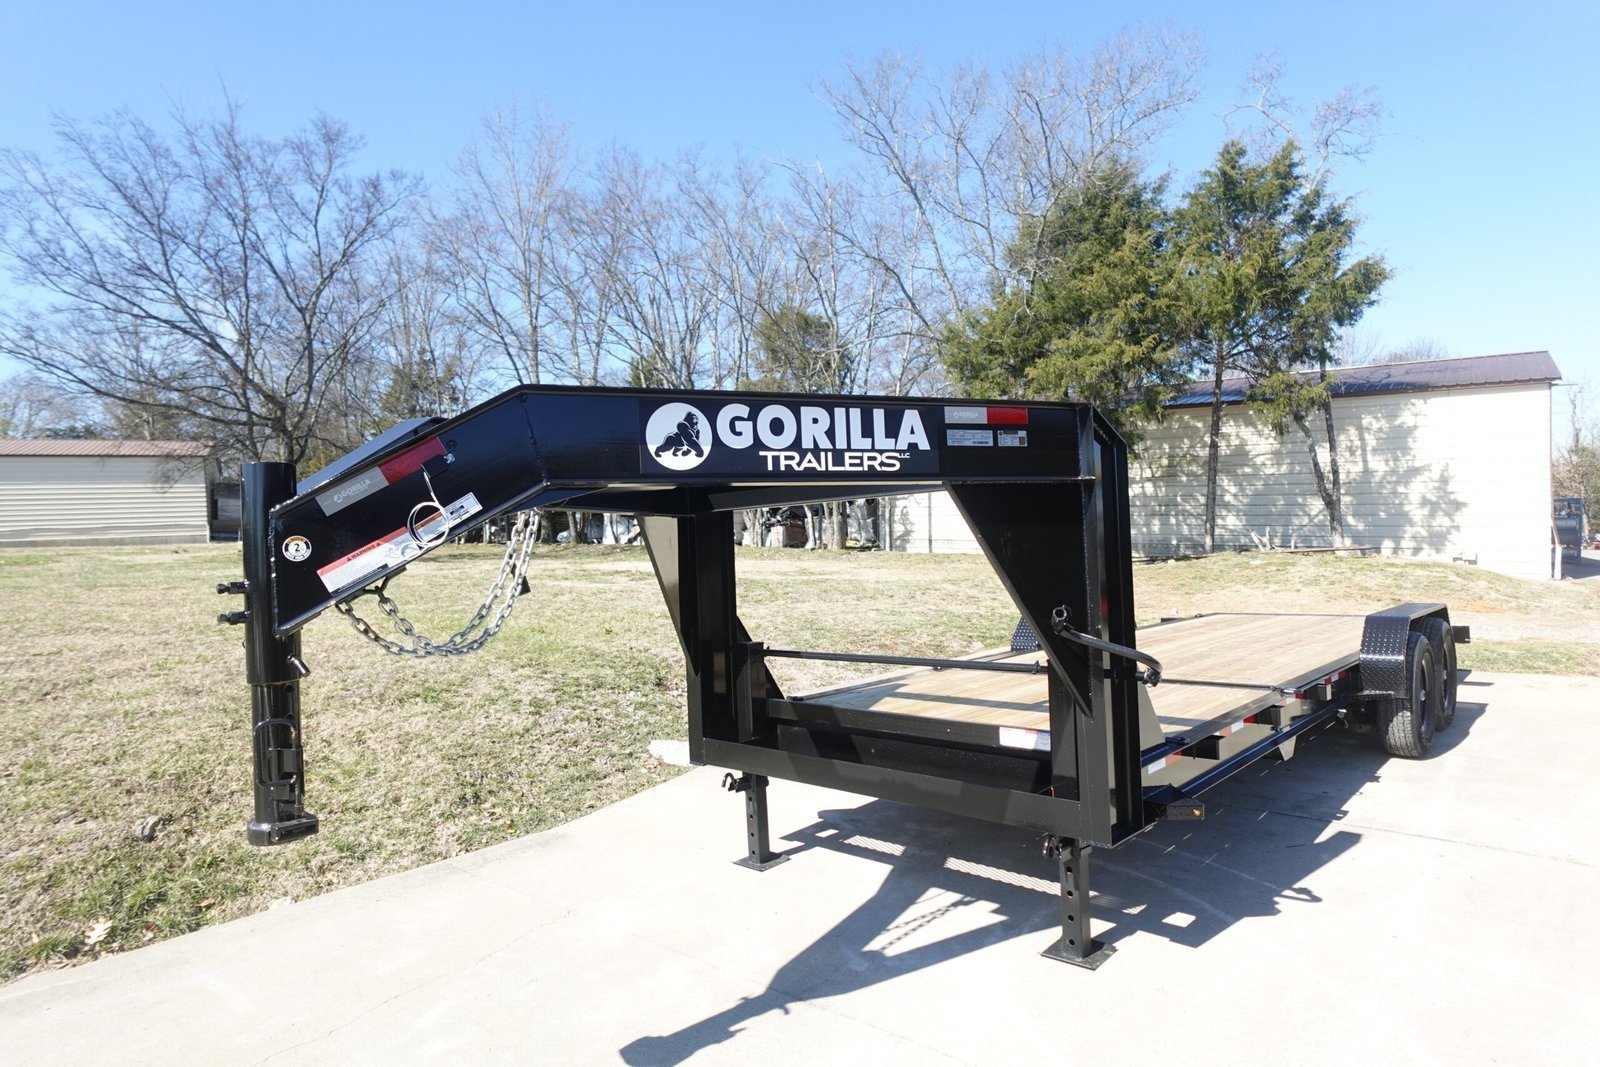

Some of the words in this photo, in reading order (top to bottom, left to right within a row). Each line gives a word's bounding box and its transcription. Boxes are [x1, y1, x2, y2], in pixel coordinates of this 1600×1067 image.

[716, 403, 931, 450] GORILLA
[759, 451, 900, 472] TRAILERS
[341, 479, 371, 497] GORILLA
[294, 543, 300, 552] 2
[352, 544, 376, 559] WARNING
